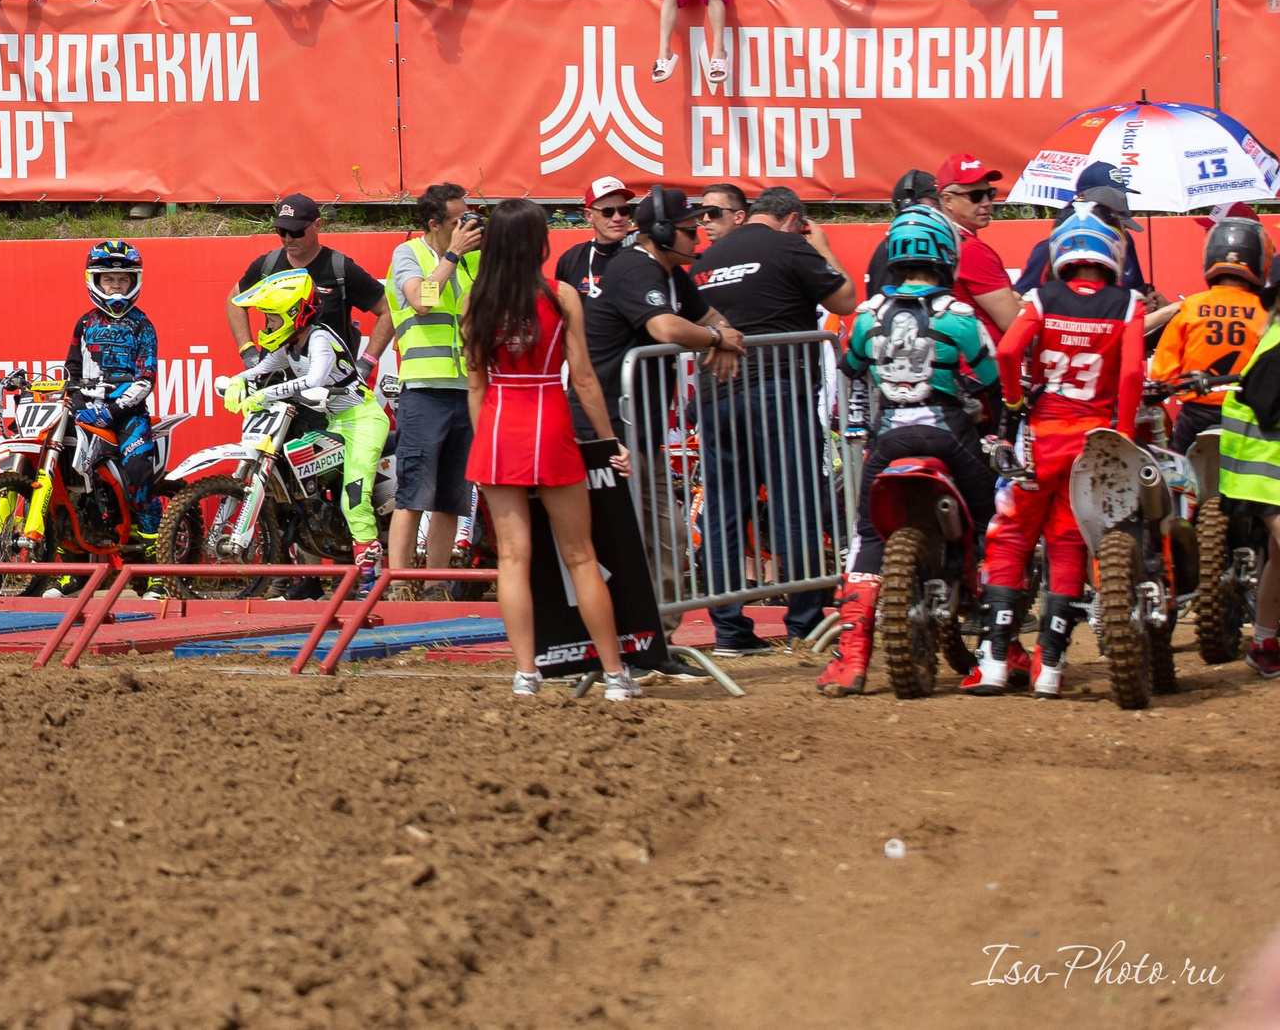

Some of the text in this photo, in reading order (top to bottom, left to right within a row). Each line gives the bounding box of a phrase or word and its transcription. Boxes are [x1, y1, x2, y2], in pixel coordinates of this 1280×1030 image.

[690, 10, 1064, 100] МОСКОВСКИЙ
[691, 106, 863, 180] СПОРТ
[1198, 158, 1228, 180] 13
[1199, 304, 1257, 320] GOEV
[1206, 321, 1246, 346] 36
[20, 405, 57, 428] 117
[297, 448, 345, 477] ТАТАРСТА
